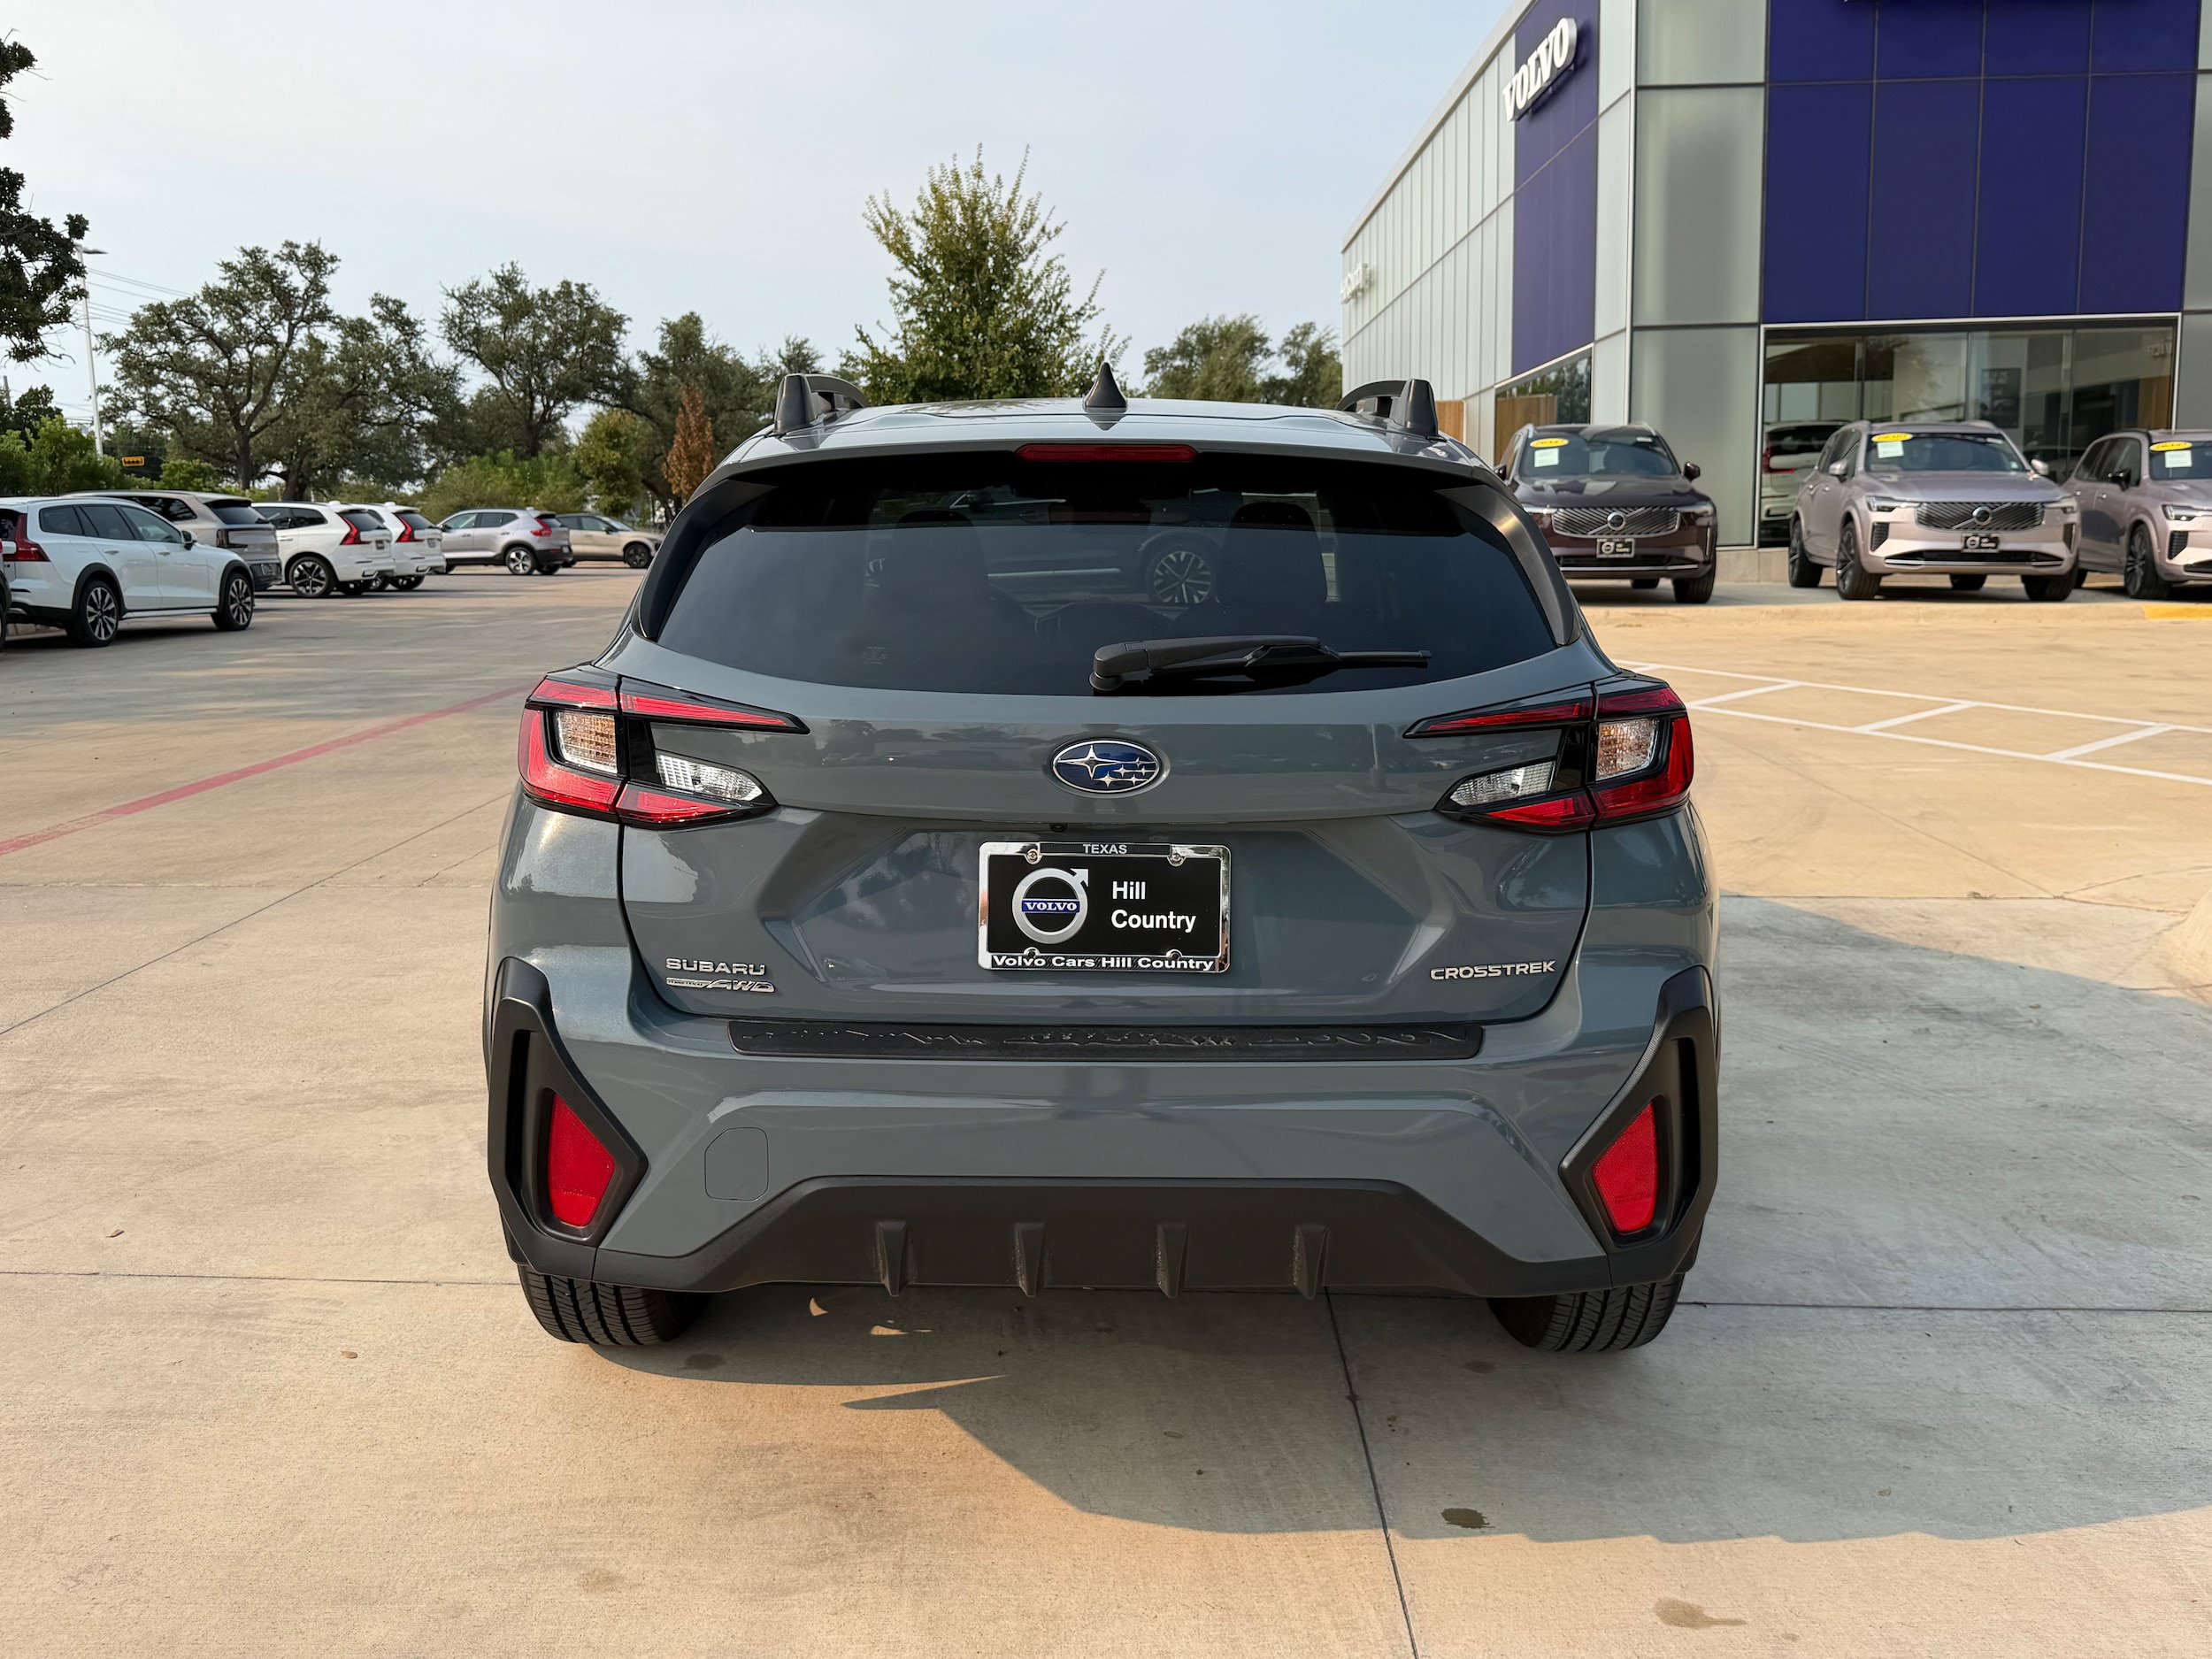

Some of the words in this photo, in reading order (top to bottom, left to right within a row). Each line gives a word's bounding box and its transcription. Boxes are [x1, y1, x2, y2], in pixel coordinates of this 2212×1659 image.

[1502, 18, 1576, 122] VOLVO
[1082, 843, 1128, 855] TEXAS
[1112, 880, 1147, 900] Hill
[1024, 901, 1078, 911] VOLVO
[1110, 909, 1197, 933] Country
[665, 957, 765, 976] SUBARU
[992, 956, 1046, 967] Volvo
[1051, 956, 1095, 968] Cars
[1102, 956, 1132, 968] Hill
[1137, 957, 1214, 972] Country
[1430, 960, 1556, 980] CROSSTREK
[706, 978, 776, 993] AWD
